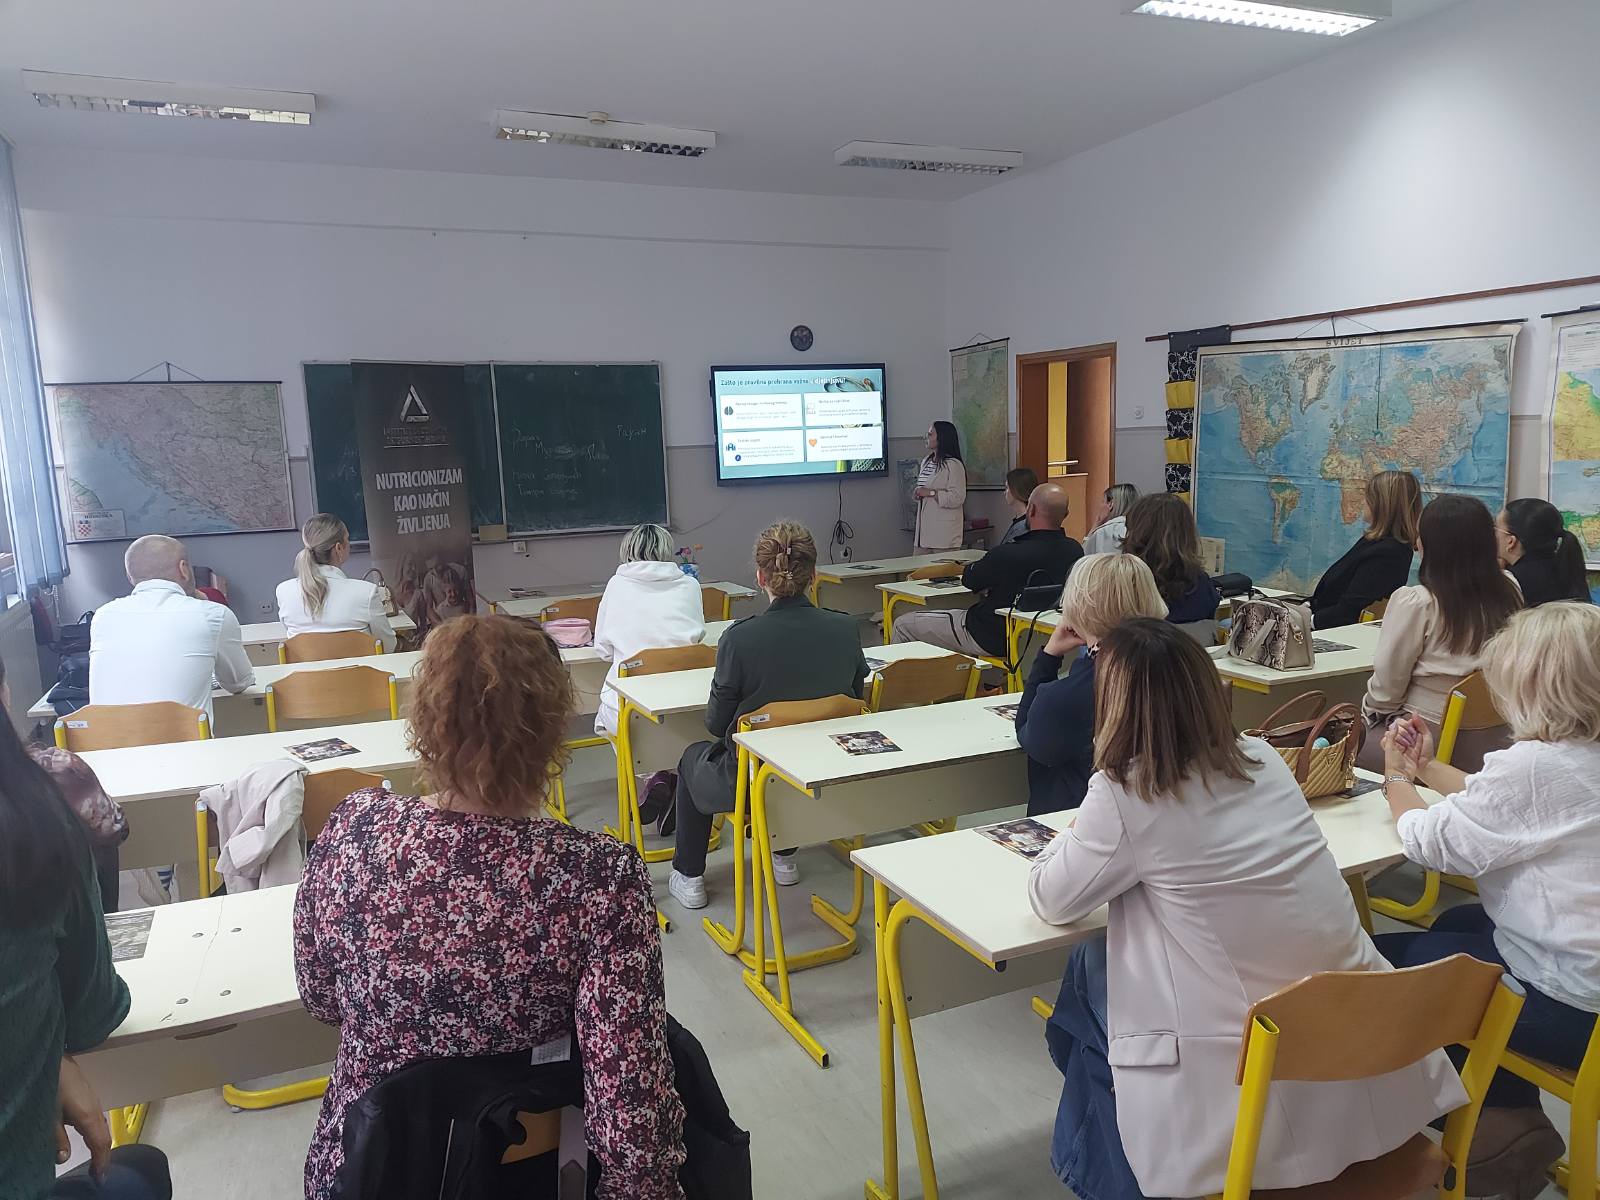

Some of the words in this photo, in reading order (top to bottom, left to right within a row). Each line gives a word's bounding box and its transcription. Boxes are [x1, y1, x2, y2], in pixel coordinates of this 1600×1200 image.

[375, 468, 463, 490] NUTRICIONIZAM
[393, 494, 418, 512] KAO
[418, 489, 451, 510] NAČIN
[396, 513, 451, 534] ŽIVLJENJA
